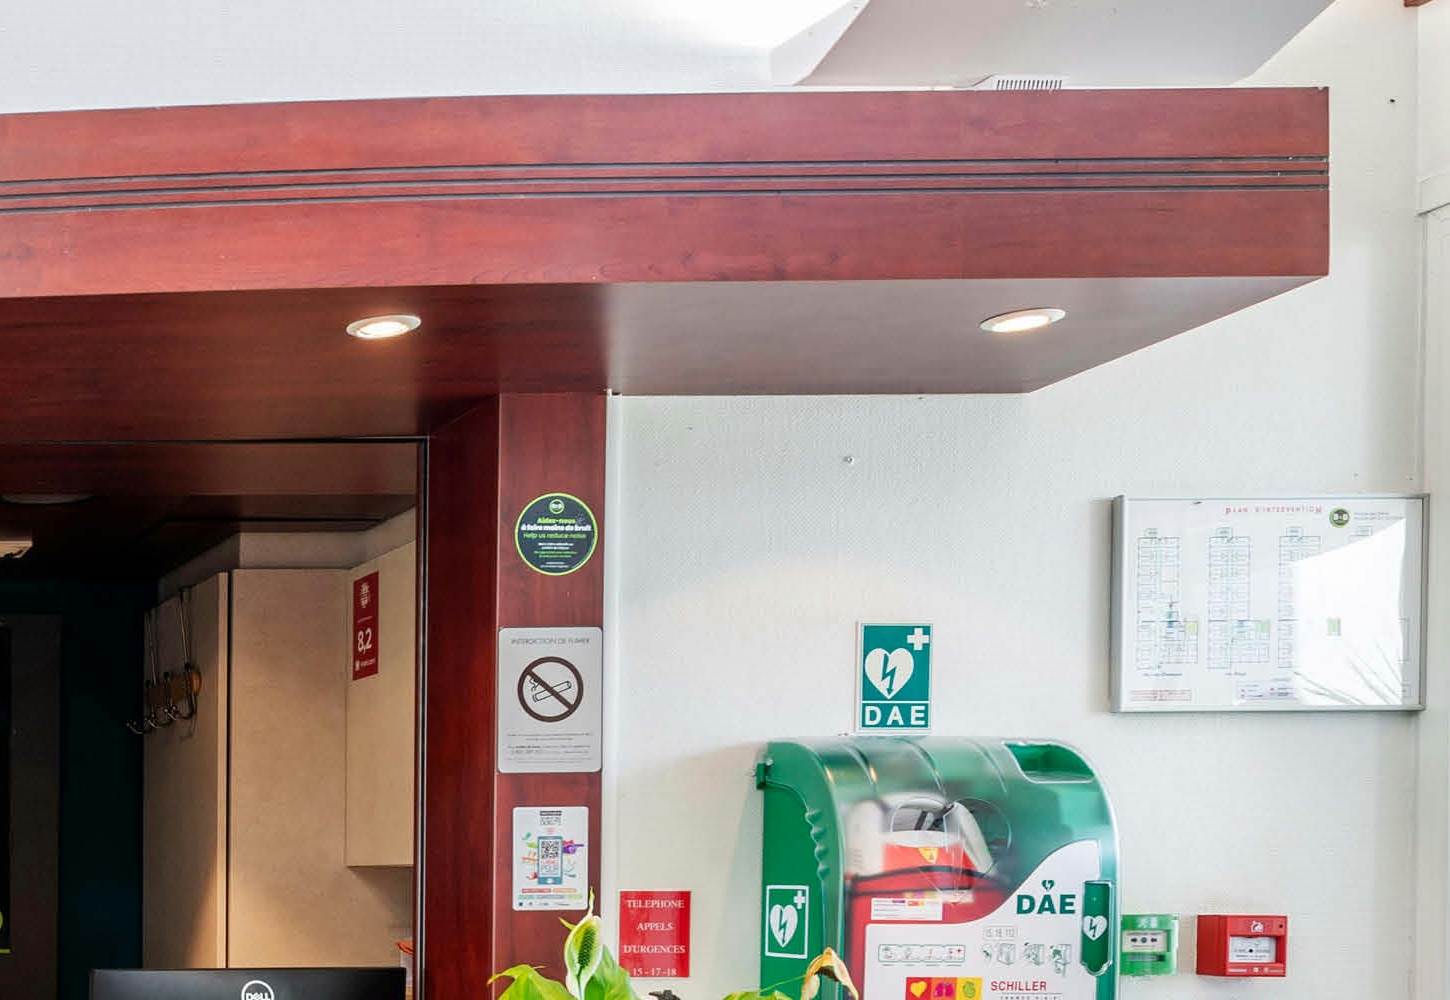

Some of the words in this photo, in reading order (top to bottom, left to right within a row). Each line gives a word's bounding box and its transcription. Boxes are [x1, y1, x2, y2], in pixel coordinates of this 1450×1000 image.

[864, 705, 927, 726] DAE
[627, 899, 685, 909] TELEPHONE
[1017, 894, 1076, 914] DAE
[636, 922, 674, 931] APPELS
[633, 967, 644, 977] 15
[990, 980, 1047, 991] SCHILLER
